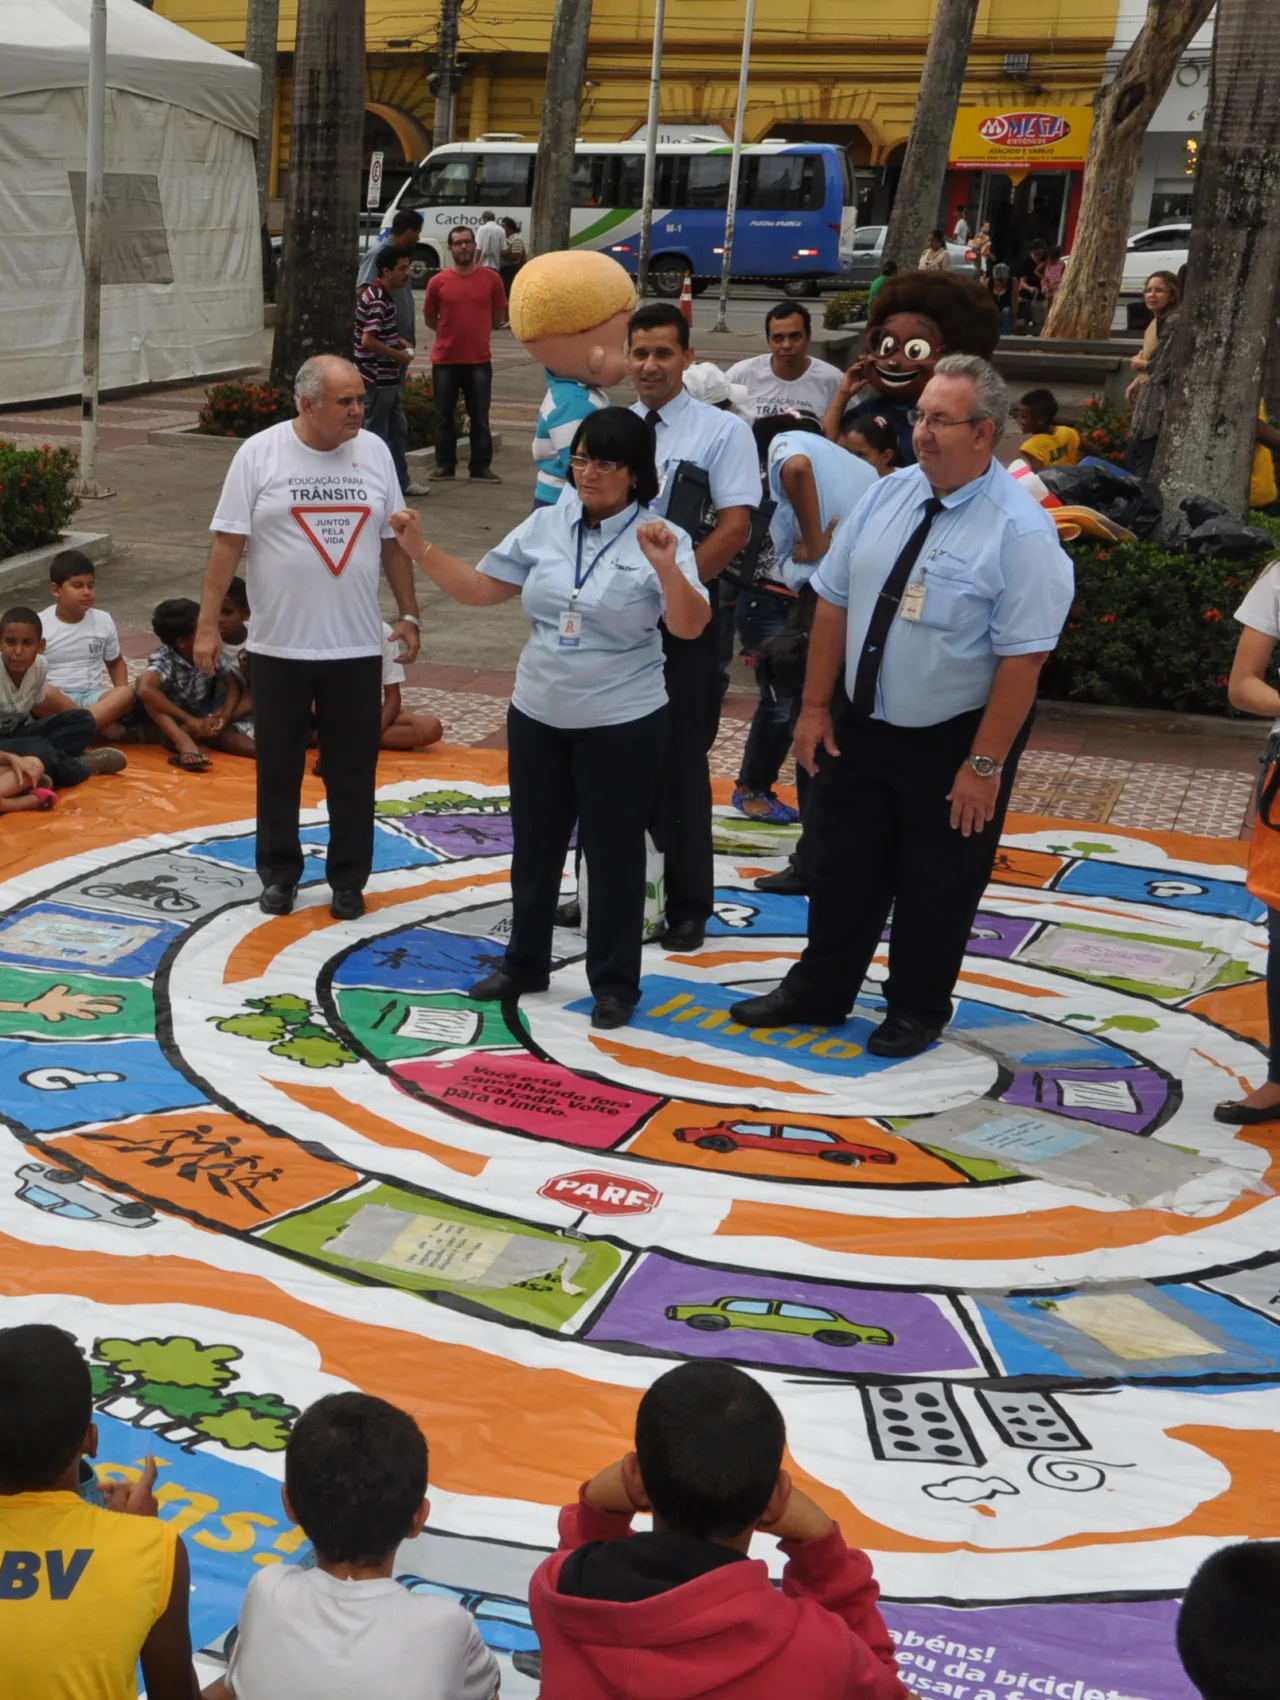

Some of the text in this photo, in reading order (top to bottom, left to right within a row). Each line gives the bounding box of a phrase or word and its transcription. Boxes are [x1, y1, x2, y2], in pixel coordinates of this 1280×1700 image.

[756, 396, 814, 409] EDUCAÇÃO PARA
[288, 475, 365, 487] EDUCAÇÃO PARA
[289, 486, 368, 501] TRÂNSITO
[315, 518, 351, 527] JUNTOS
[321, 527, 345, 536] PELA
[324, 536, 345, 545] VIDA
[473, 1066, 562, 1087] Você está
[462, 1074, 632, 1109] caminhando fora
[442, 1087, 568, 1117] para o início.
[568, 1101, 621, 1116] Volte
[887, 1629, 997, 1664] abéns!
[943, 1661, 987, 1683] da
